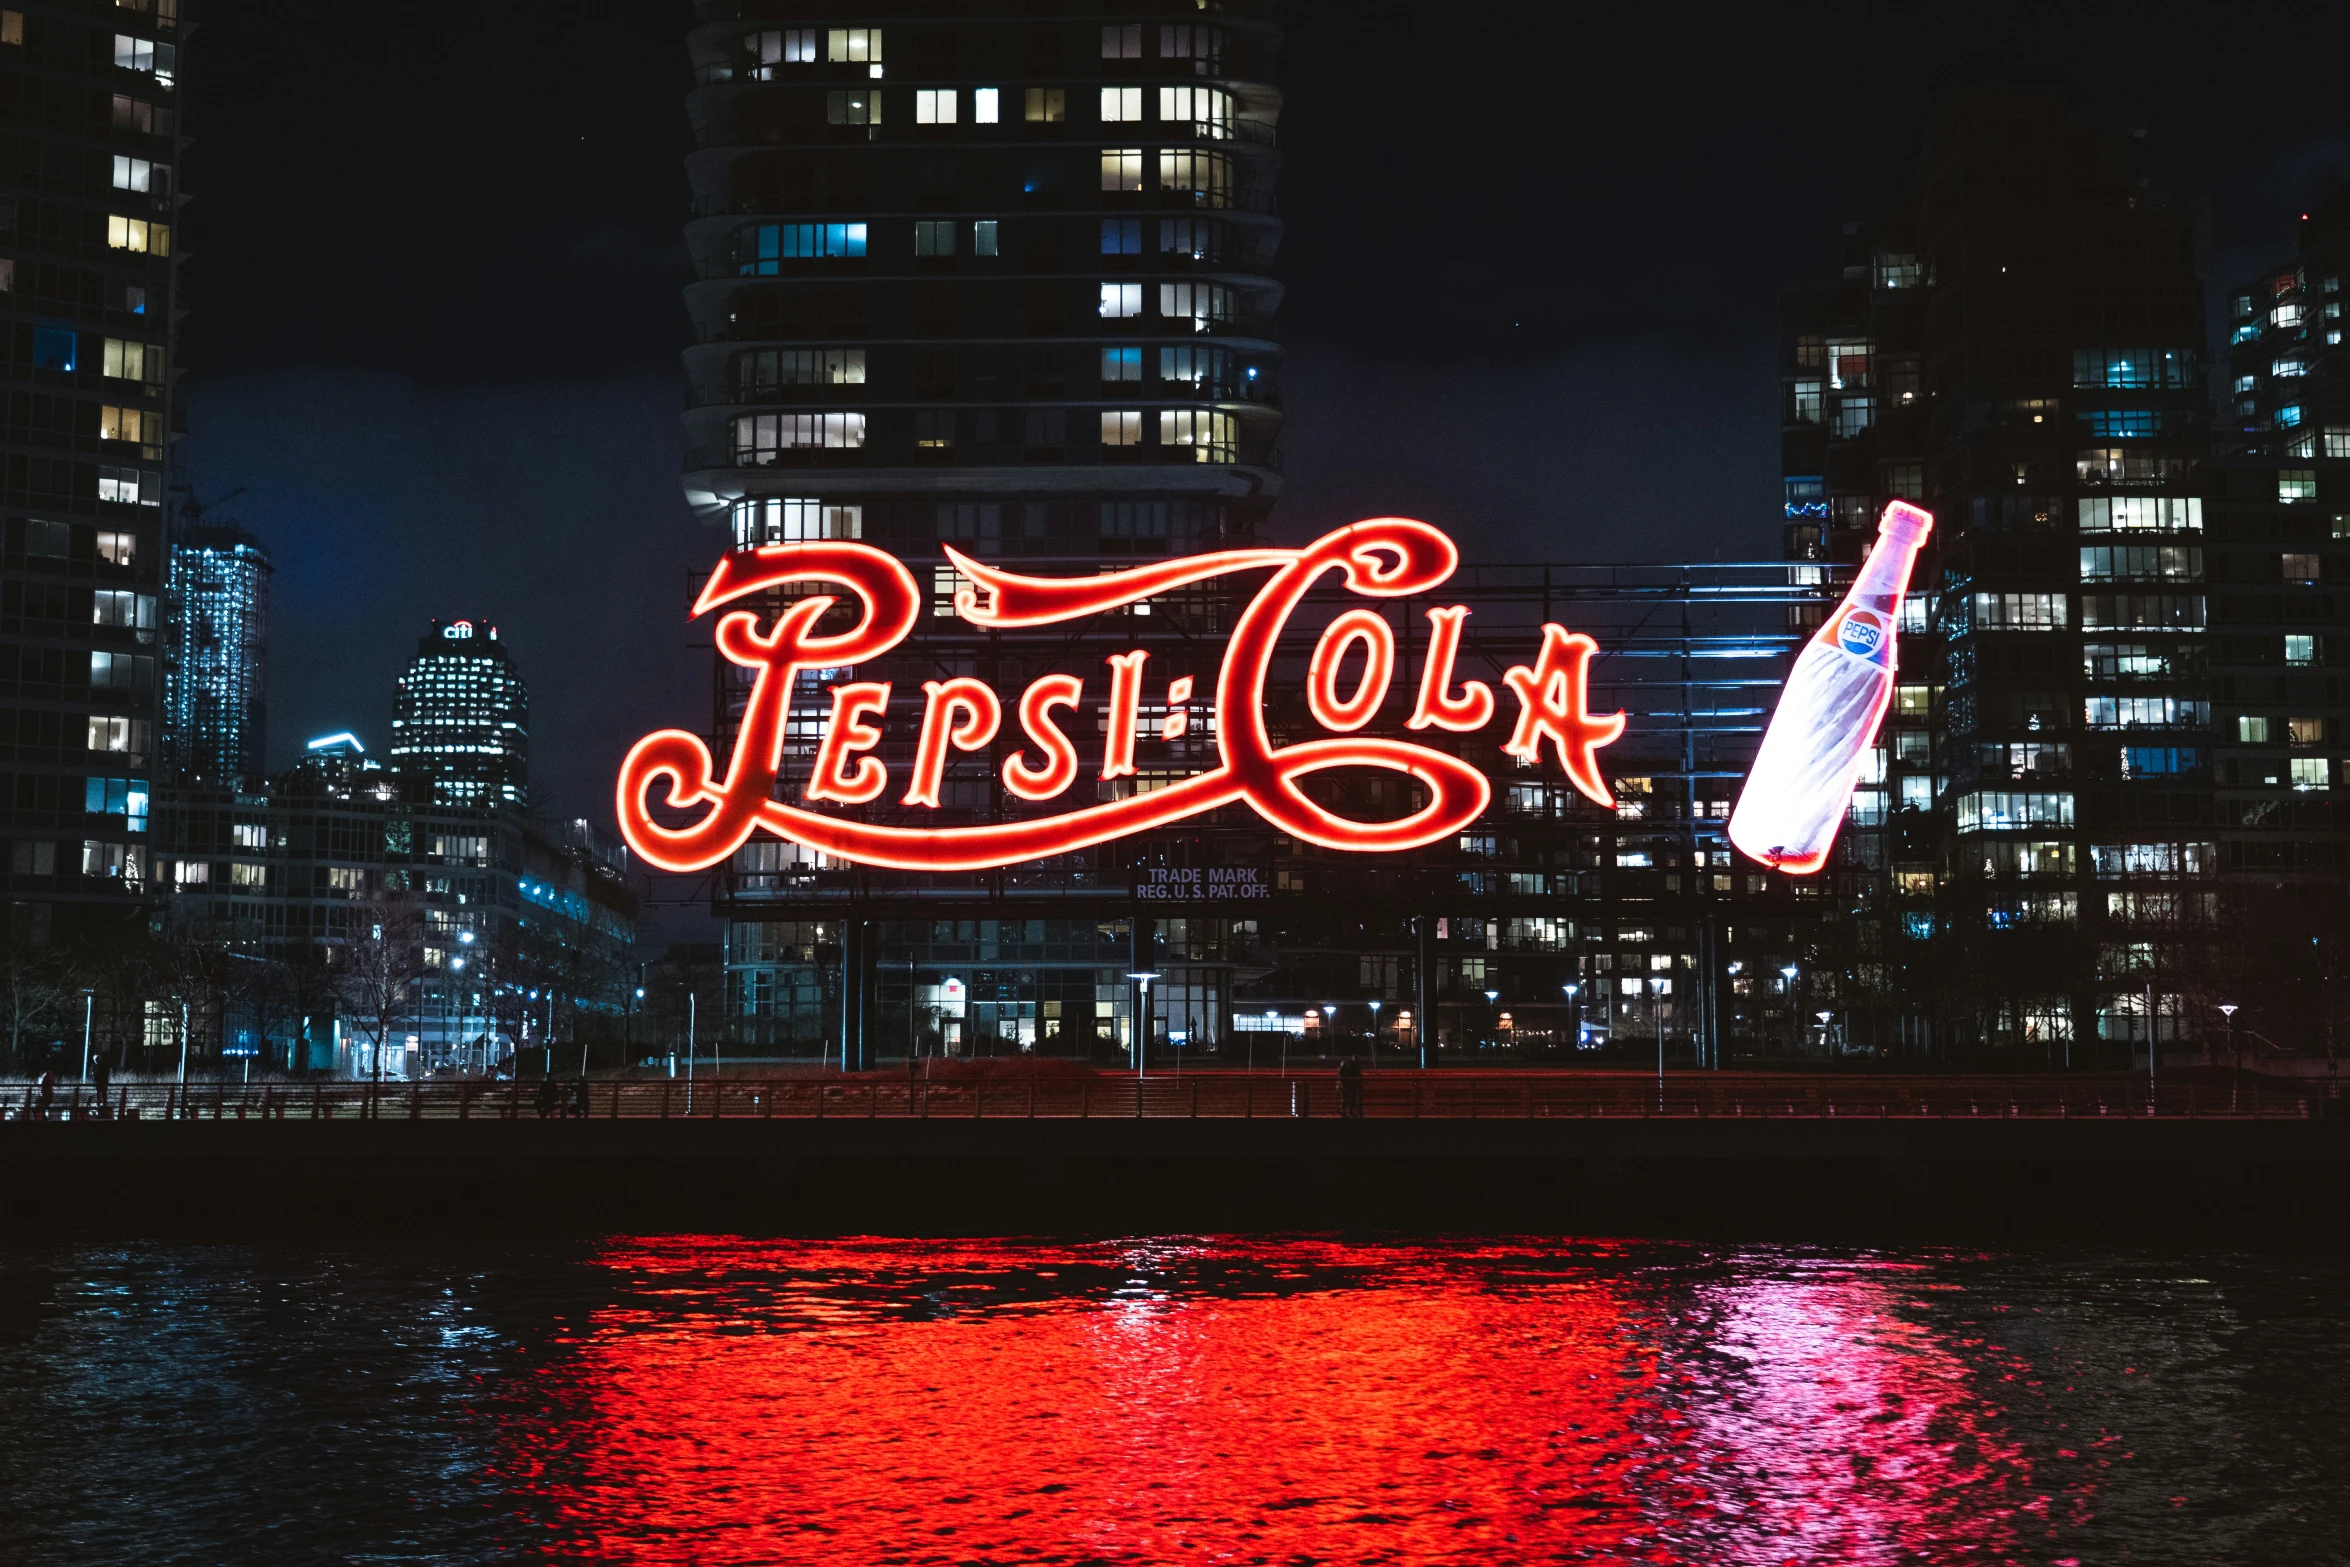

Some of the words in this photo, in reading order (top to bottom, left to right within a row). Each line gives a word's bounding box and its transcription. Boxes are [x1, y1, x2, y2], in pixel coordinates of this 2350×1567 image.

[443, 624, 473, 639] citi
[1843, 621, 1880, 646] PEPSI
[1149, 868, 1201, 883] TRADE
[1209, 868, 1257, 883] MARK
[1137, 884, 1171, 899] REG.
[1208, 884, 1239, 899] PAT.
[1240, 884, 1271, 899] OFF.
